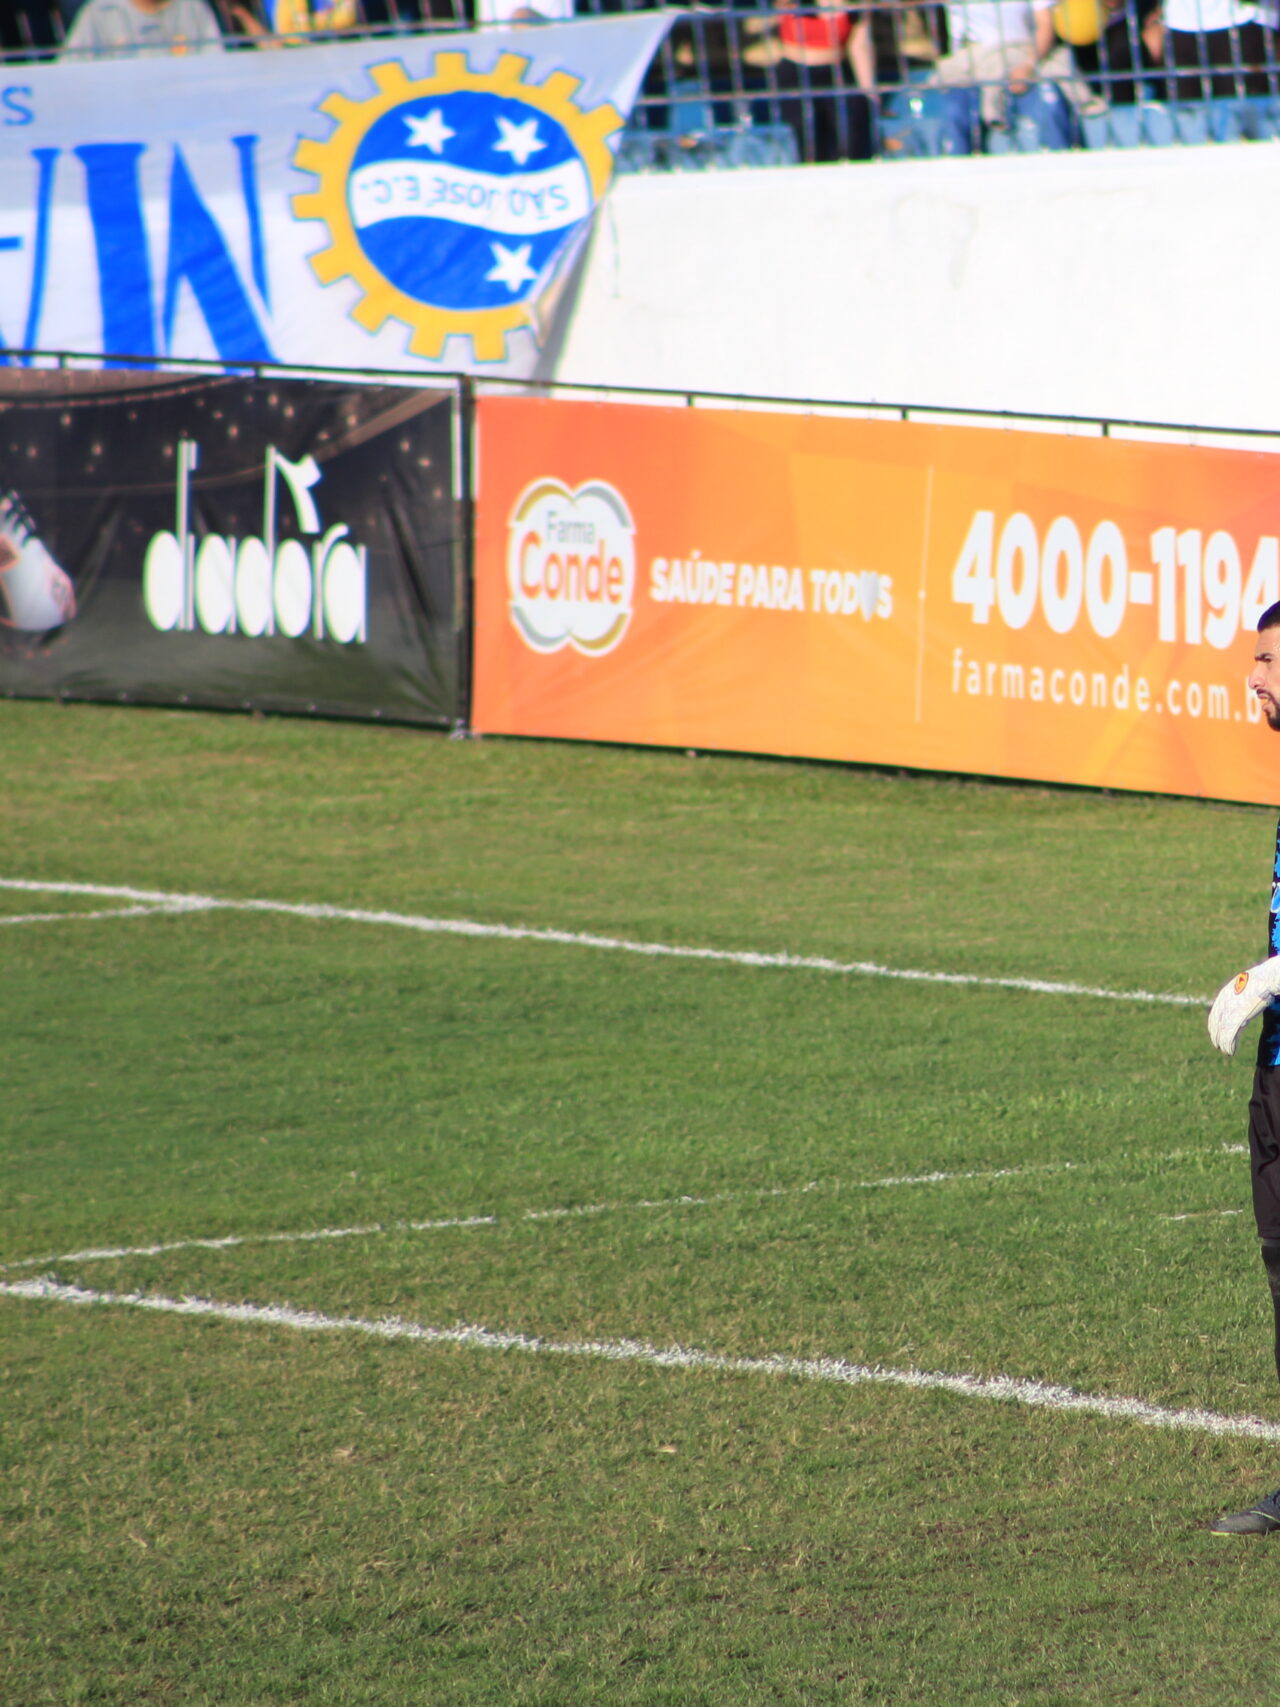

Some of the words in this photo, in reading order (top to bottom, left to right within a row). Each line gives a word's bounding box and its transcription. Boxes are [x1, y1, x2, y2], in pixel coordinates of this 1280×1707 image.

[545, 510, 597, 545] Farma
[518, 530, 624, 605] Conde
[649, 549, 735, 607] SAÚDE
[738, 564, 805, 612] PARA
[951, 509, 1280, 651] 4000-1194
